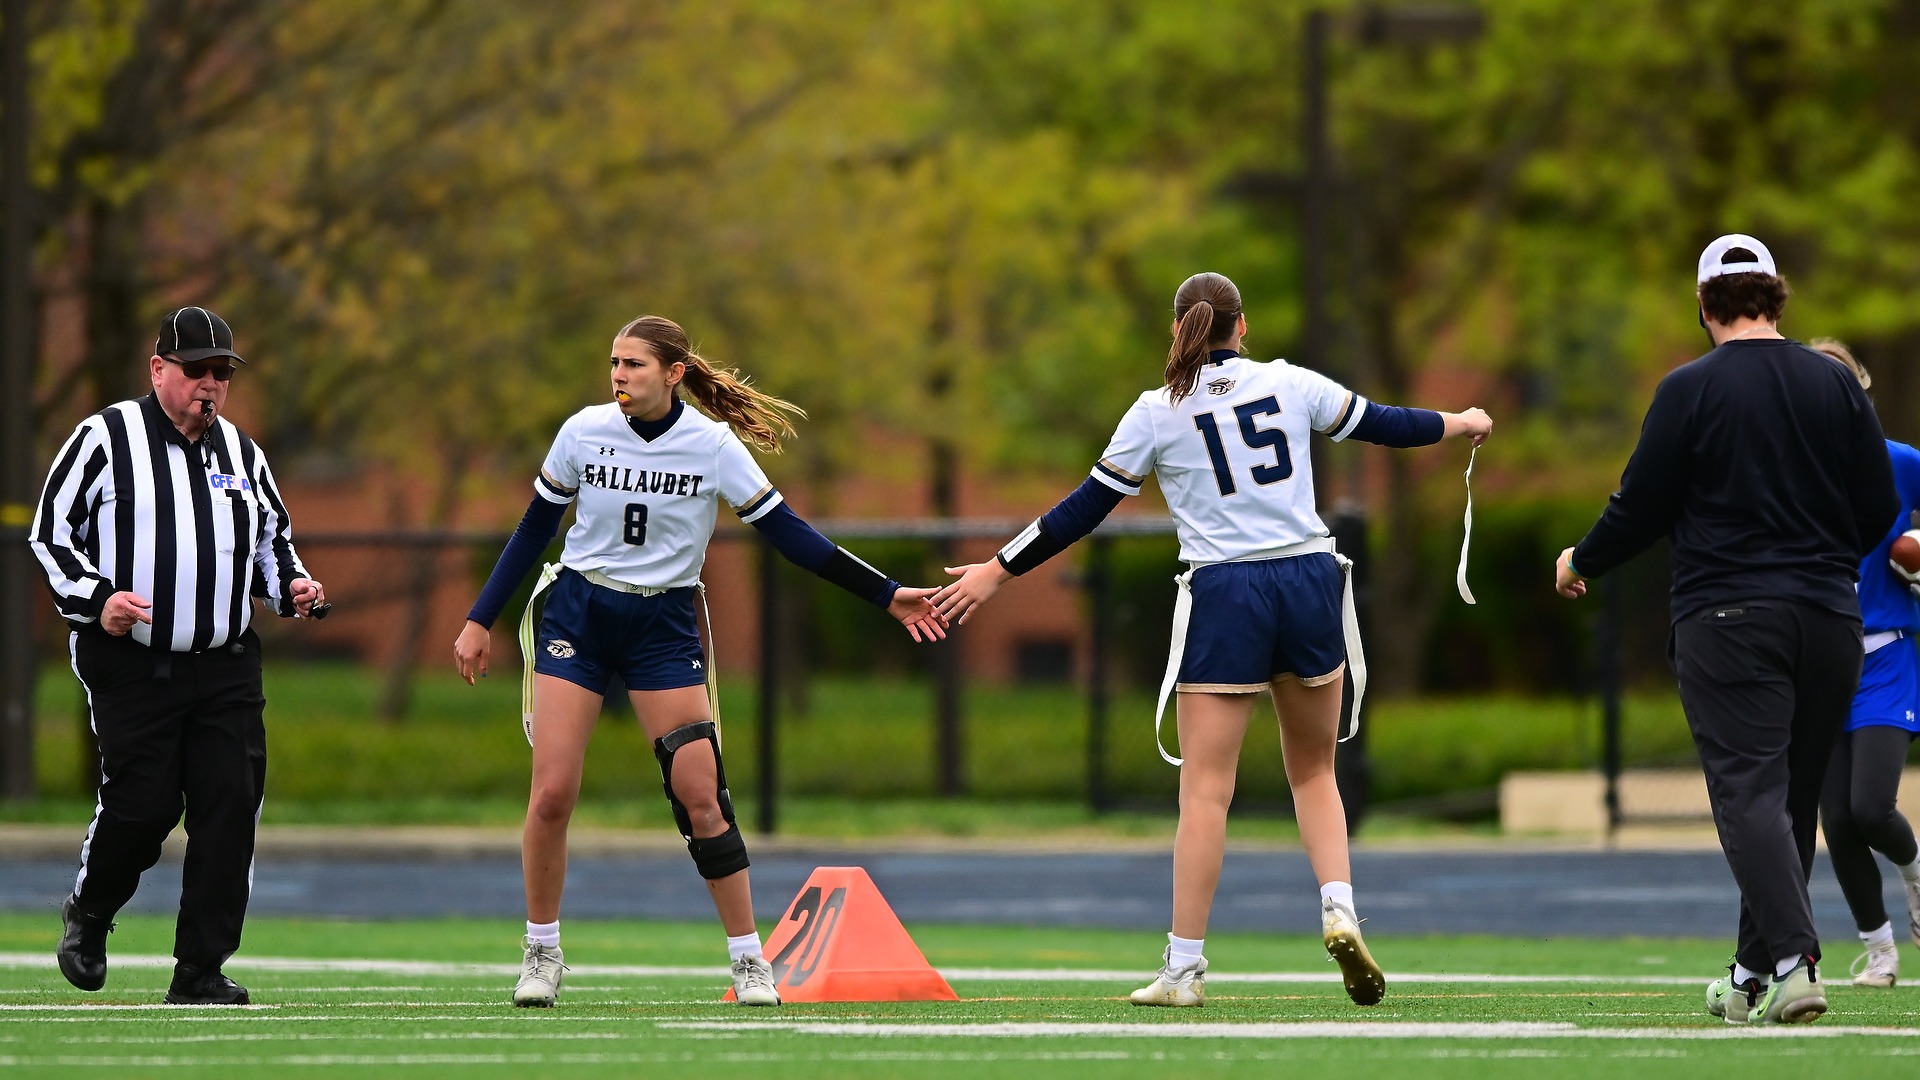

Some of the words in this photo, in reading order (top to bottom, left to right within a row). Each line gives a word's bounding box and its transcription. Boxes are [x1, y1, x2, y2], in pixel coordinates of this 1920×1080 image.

[584, 464, 704, 497] GALLAUDET
[1192, 393, 1294, 498] 15
[623, 502, 648, 546] 8
[771, 886, 847, 987] 20
